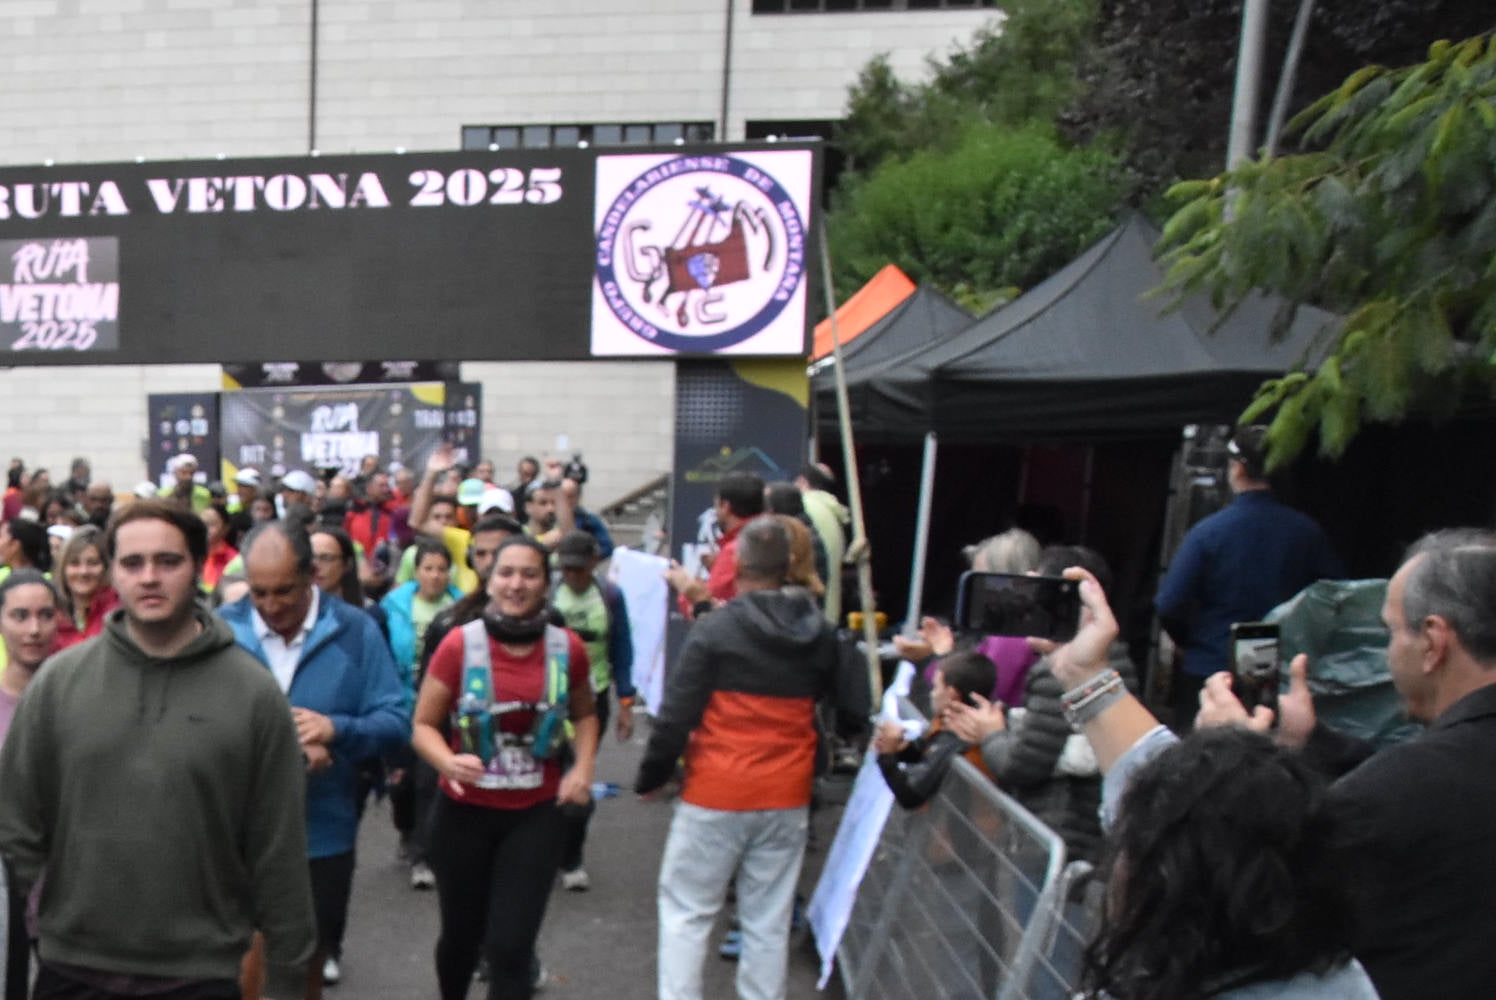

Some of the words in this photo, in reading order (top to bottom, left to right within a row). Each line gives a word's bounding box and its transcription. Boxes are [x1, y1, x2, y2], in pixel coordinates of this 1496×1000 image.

[147, 172, 391, 213] VETONA
[409, 167, 563, 206] 2025
[744, 167, 774, 192] DE
[12, 238, 89, 283] RUTA
[10, 320, 97, 351] 2025
